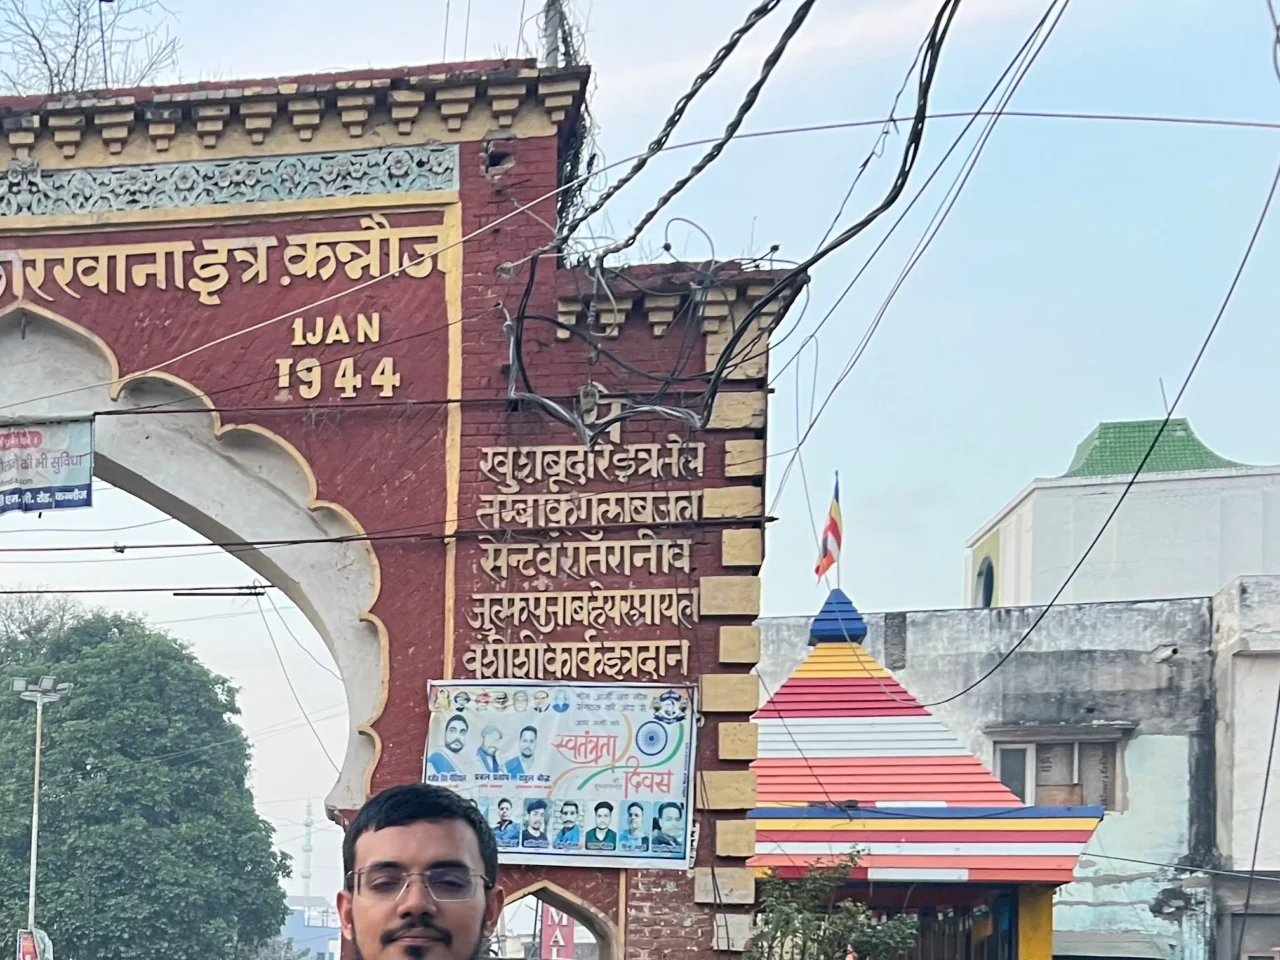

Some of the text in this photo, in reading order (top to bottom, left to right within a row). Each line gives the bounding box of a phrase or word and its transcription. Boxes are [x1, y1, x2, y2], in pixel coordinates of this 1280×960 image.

[188, 236, 278, 305] इत्र
[275, 357, 401, 401] 1944
[623, 755, 675, 799] दिवस
